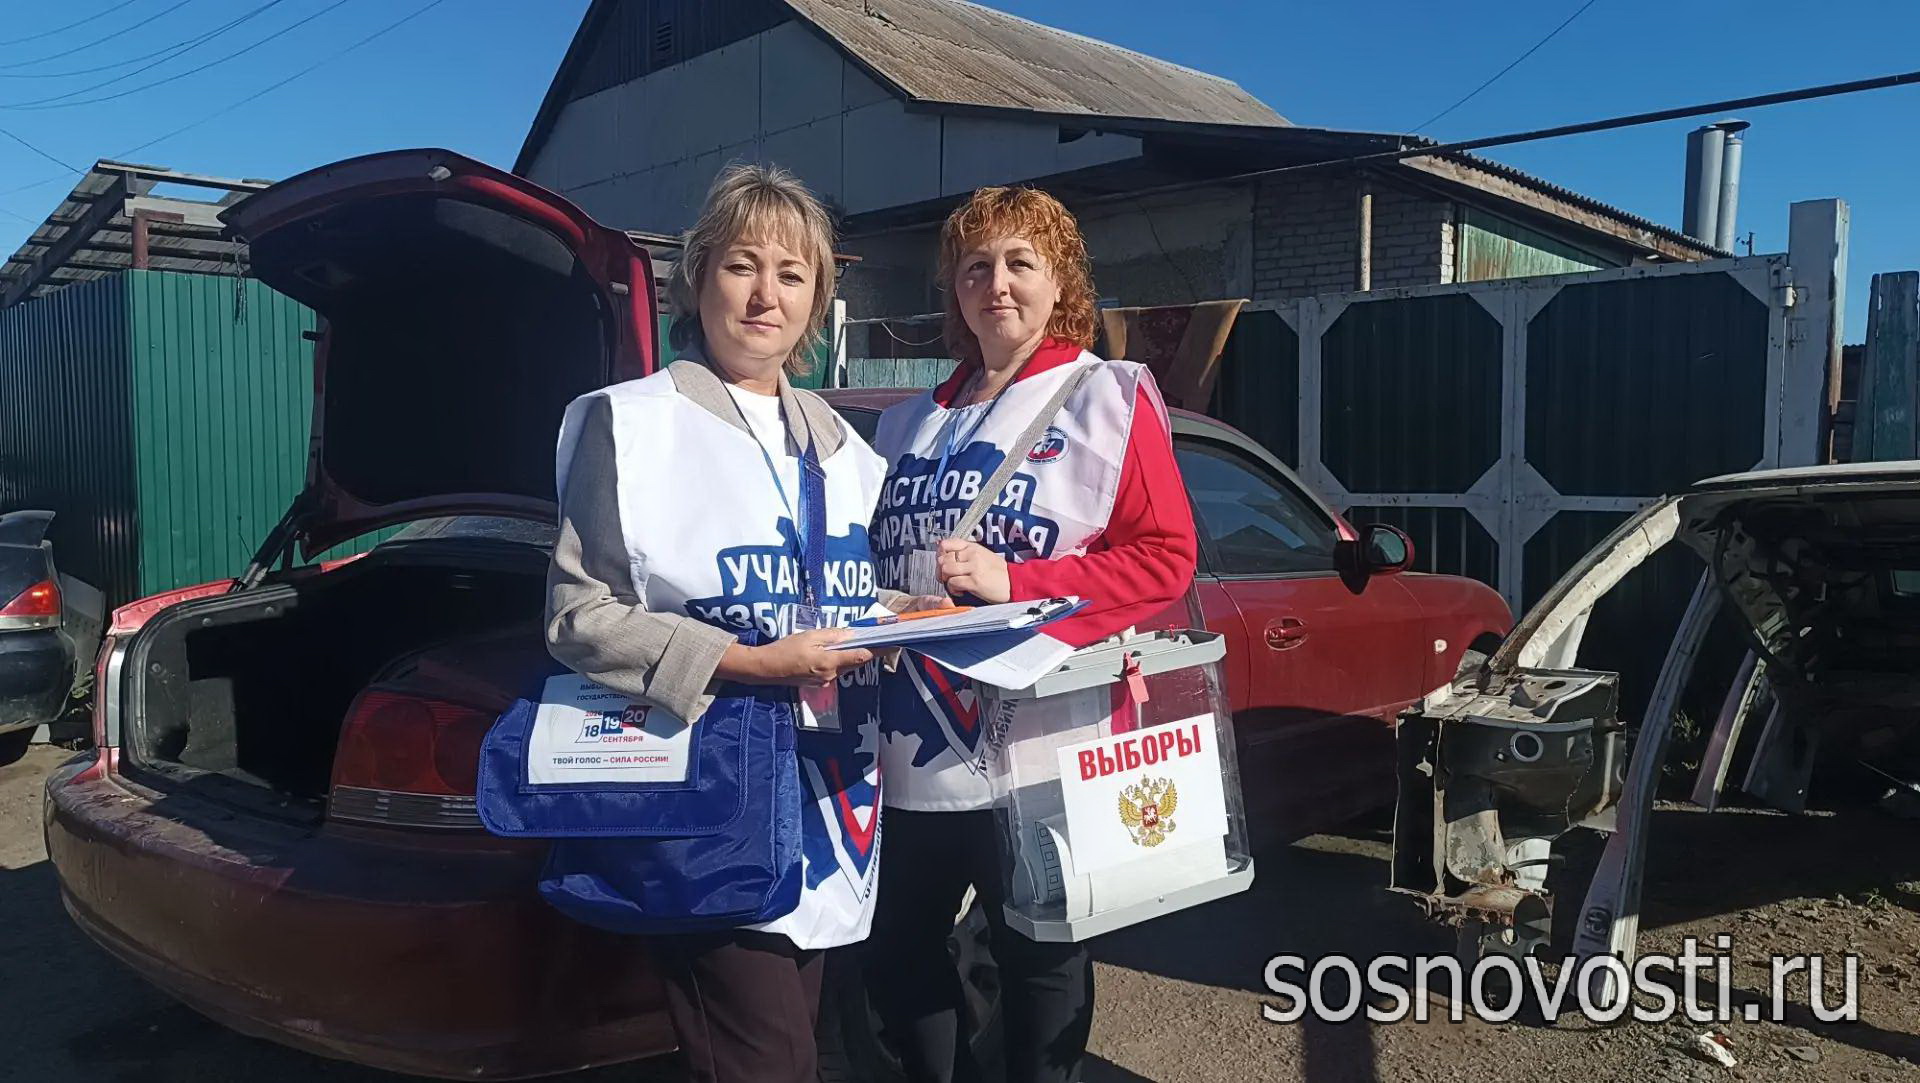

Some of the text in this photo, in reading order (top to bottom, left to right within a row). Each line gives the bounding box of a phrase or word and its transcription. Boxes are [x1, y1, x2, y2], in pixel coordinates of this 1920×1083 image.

[878, 470, 1028, 513] АСТКОВЯ
[584, 710, 645, 738] 18 19 20
[602, 735, 643, 743] СЕНТЯБРЯ
[1077, 725, 1202, 781] ВЫБОРЫ
[553, 756, 573, 764] ТВОЙ
[634, 755, 669, 763] РОССИИ!
